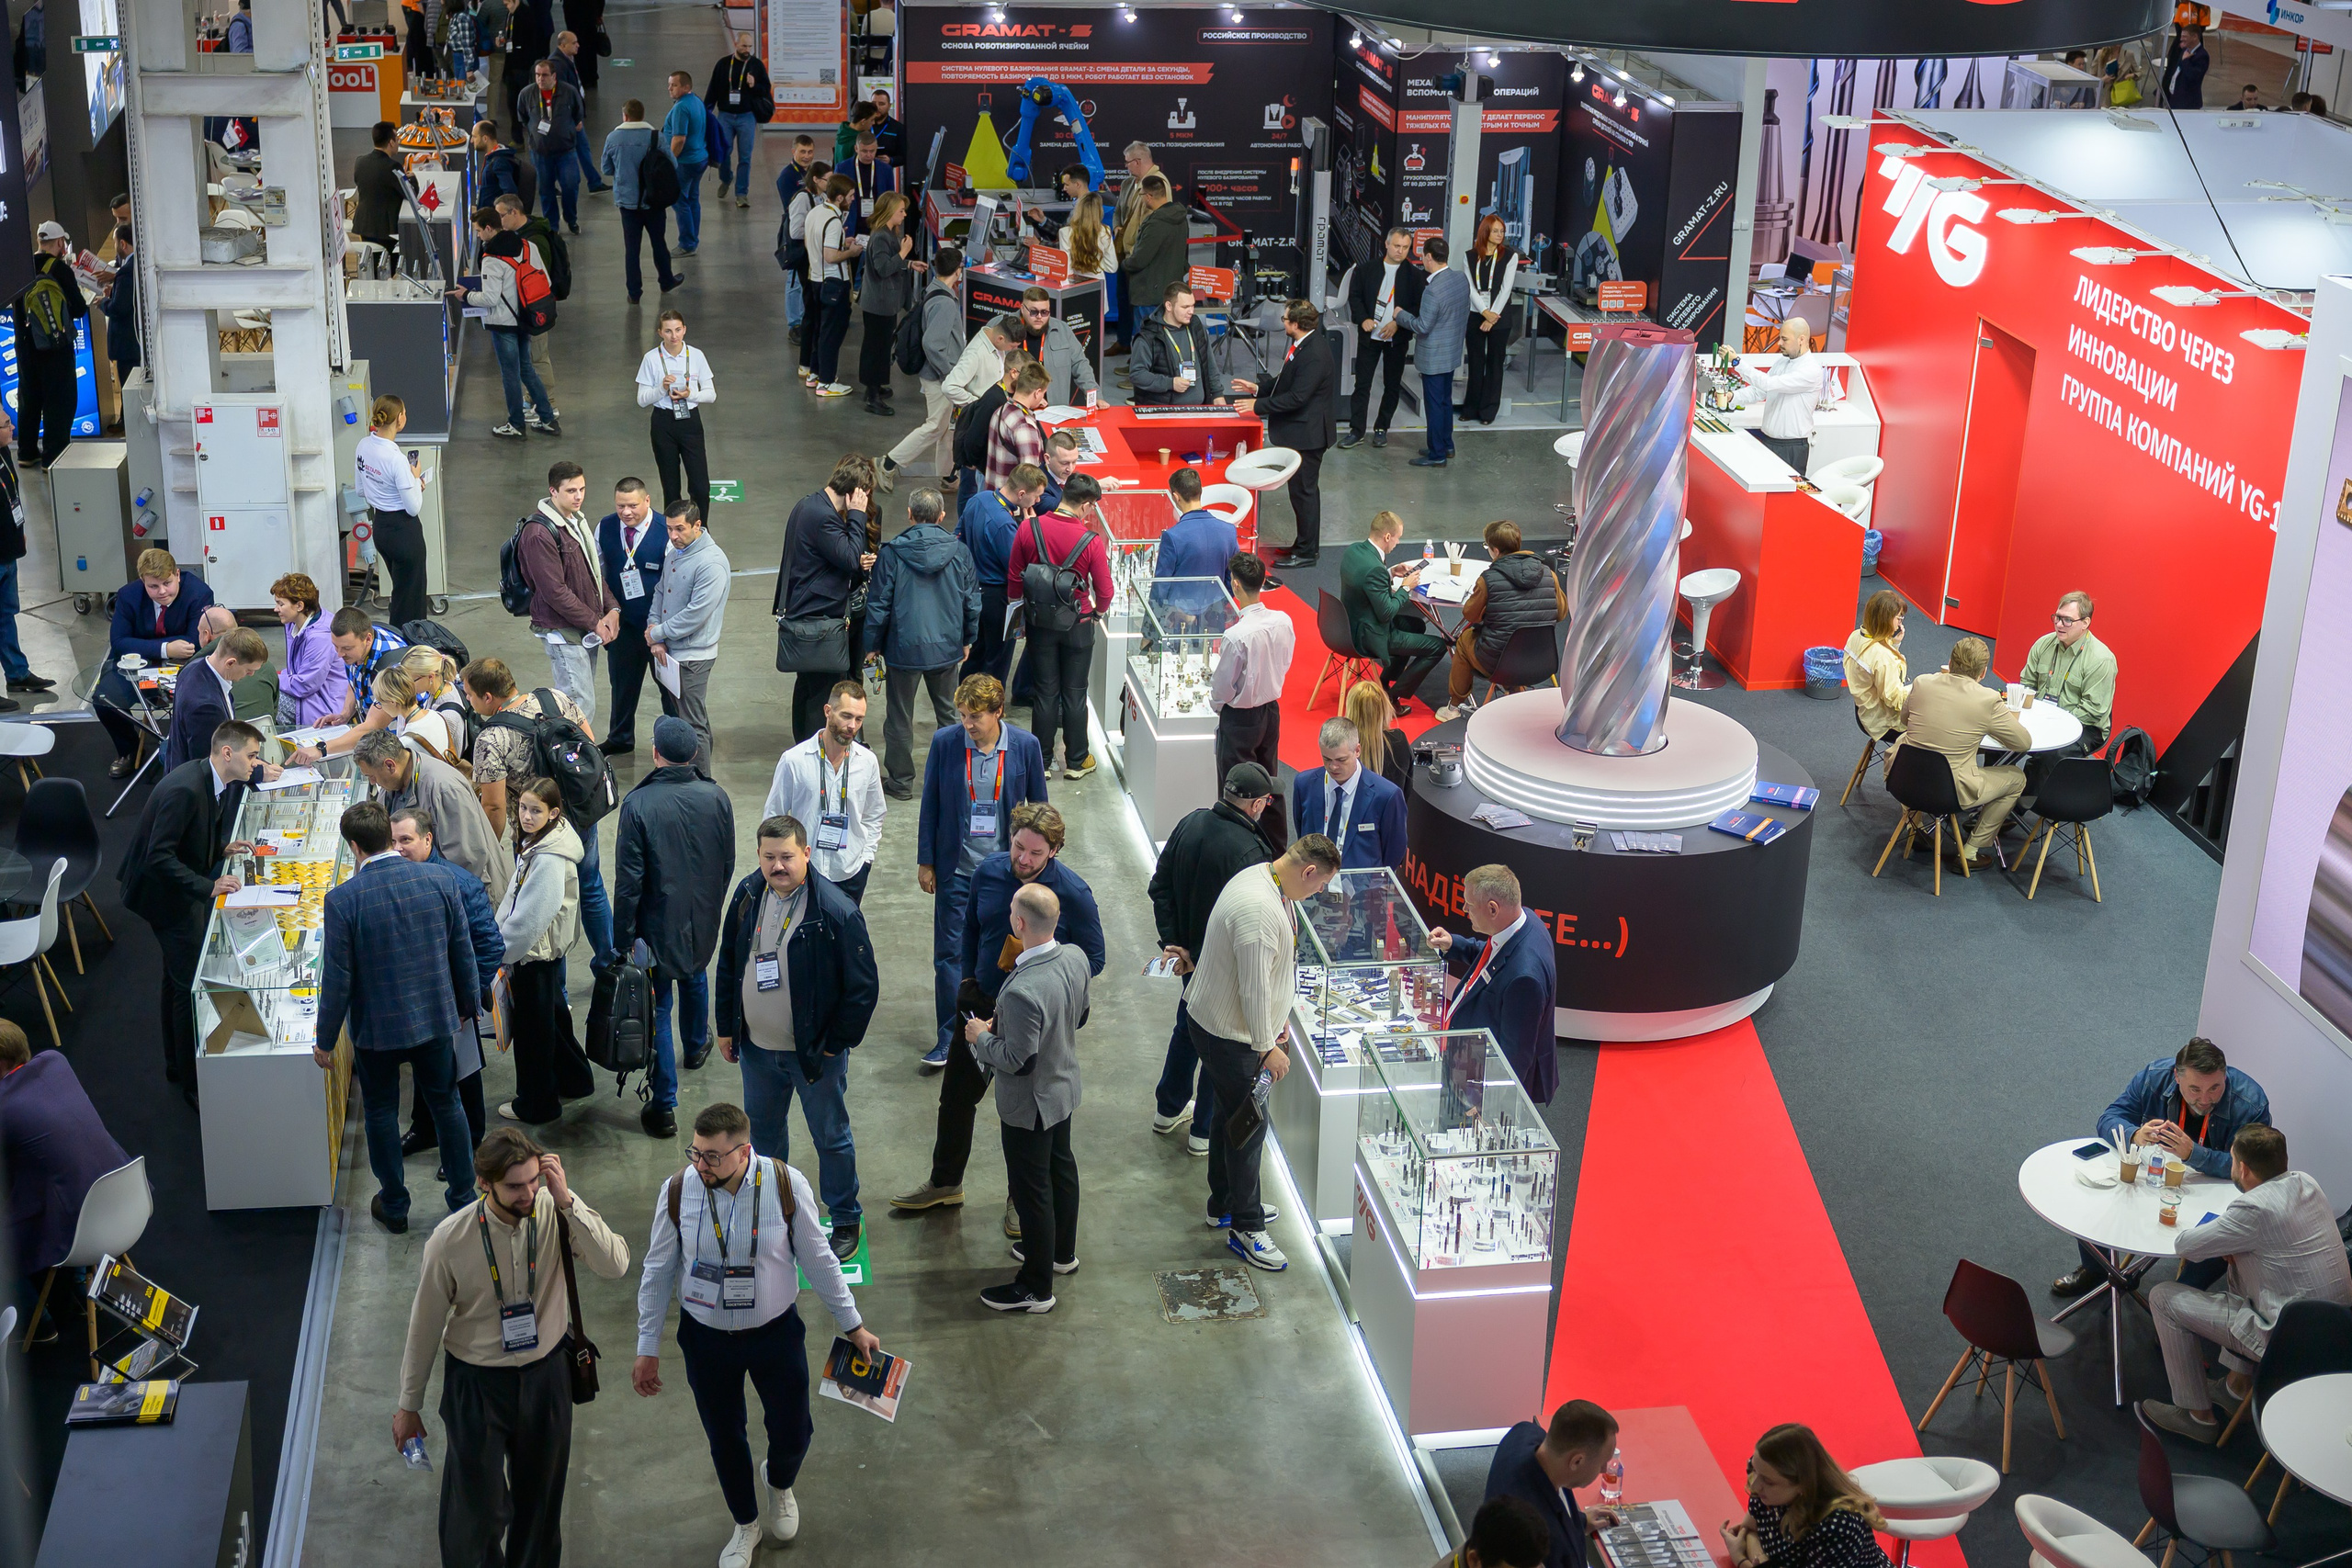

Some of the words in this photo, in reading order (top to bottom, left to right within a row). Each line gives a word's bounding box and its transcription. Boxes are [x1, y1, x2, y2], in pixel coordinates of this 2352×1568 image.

[1203, 31, 1250, 39] РОССИЙСКОЕ
[1251, 32, 1307, 40] ПРОИЗВОДСТВО
[2281, 8, 2304, 24] ИНКОР
[975, 41, 1057, 50] РОБОТИЗИРОВАННОЙ
[1058, 41, 1090, 50] ЯЧЕЙКИ
[1493, 86, 1539, 96] ОПЕРАЦИЙ
[1672, 180, 1729, 246] GRAMAT-Z.RU
[1877, 154, 1990, 288] YG
[1316, 216, 1326, 263] грамат
[1666, 292, 1694, 323] СИСТЕМА
[1672, 294, 1702, 329] НУЛЕВОГО
[2073, 275, 2176, 353] ЛИДЕРСТВО
[2178, 332, 2235, 385] ЧЕРЕЗ
[2066, 323, 2178, 412] ИННОВАЦИИ
[2060, 372, 2122, 436] ГРУППА
[2127, 416, 2236, 504] КОМПАНИЙ
